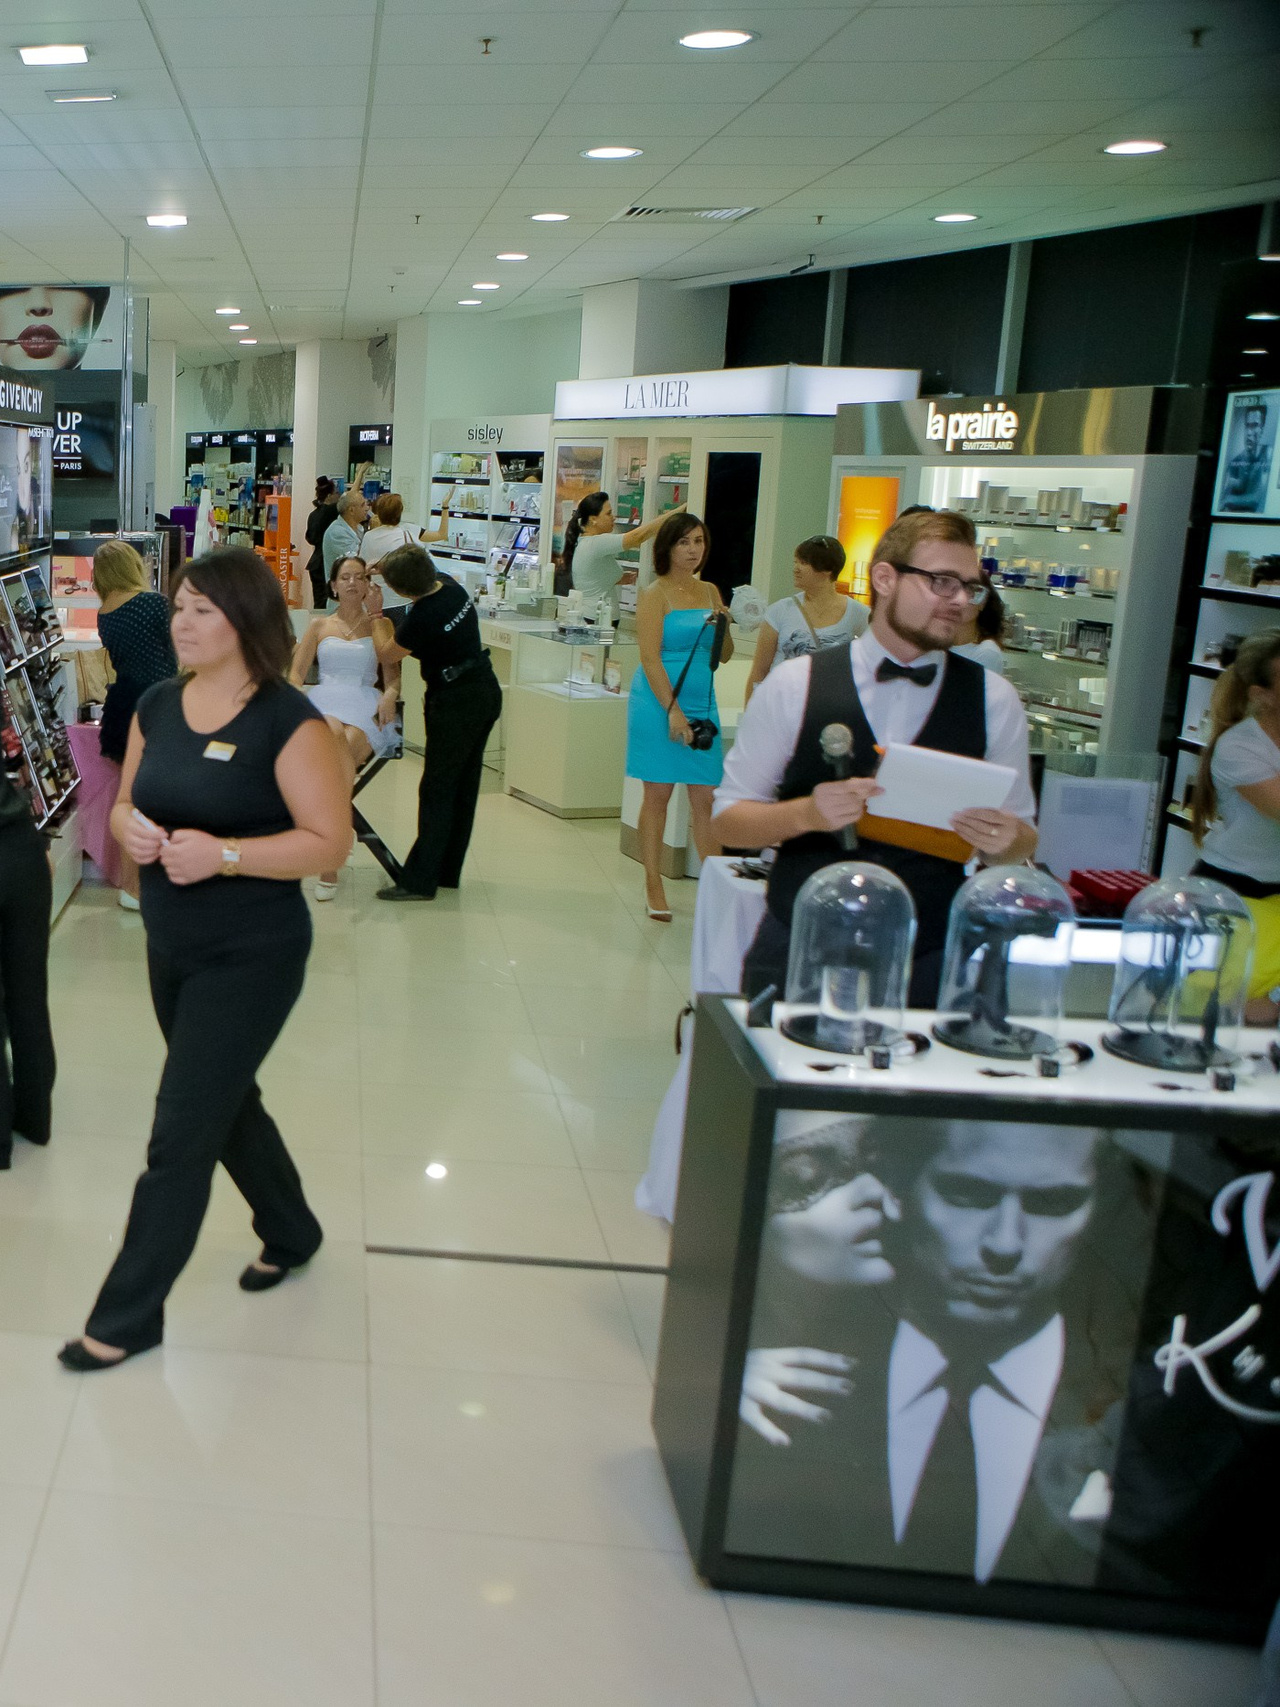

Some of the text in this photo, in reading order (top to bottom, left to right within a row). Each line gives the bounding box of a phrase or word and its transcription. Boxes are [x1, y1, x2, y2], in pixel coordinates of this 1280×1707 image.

[0, 379, 43, 414] GIVENCHY
[624, 380, 689, 409] LA MER
[57, 411, 83, 431] UP
[926, 402, 1019, 452] la prairie
[467, 424, 504, 444] sisley
[962, 441, 1014, 450] SWITZERLAND
[60, 462, 82, 470] PARIS
